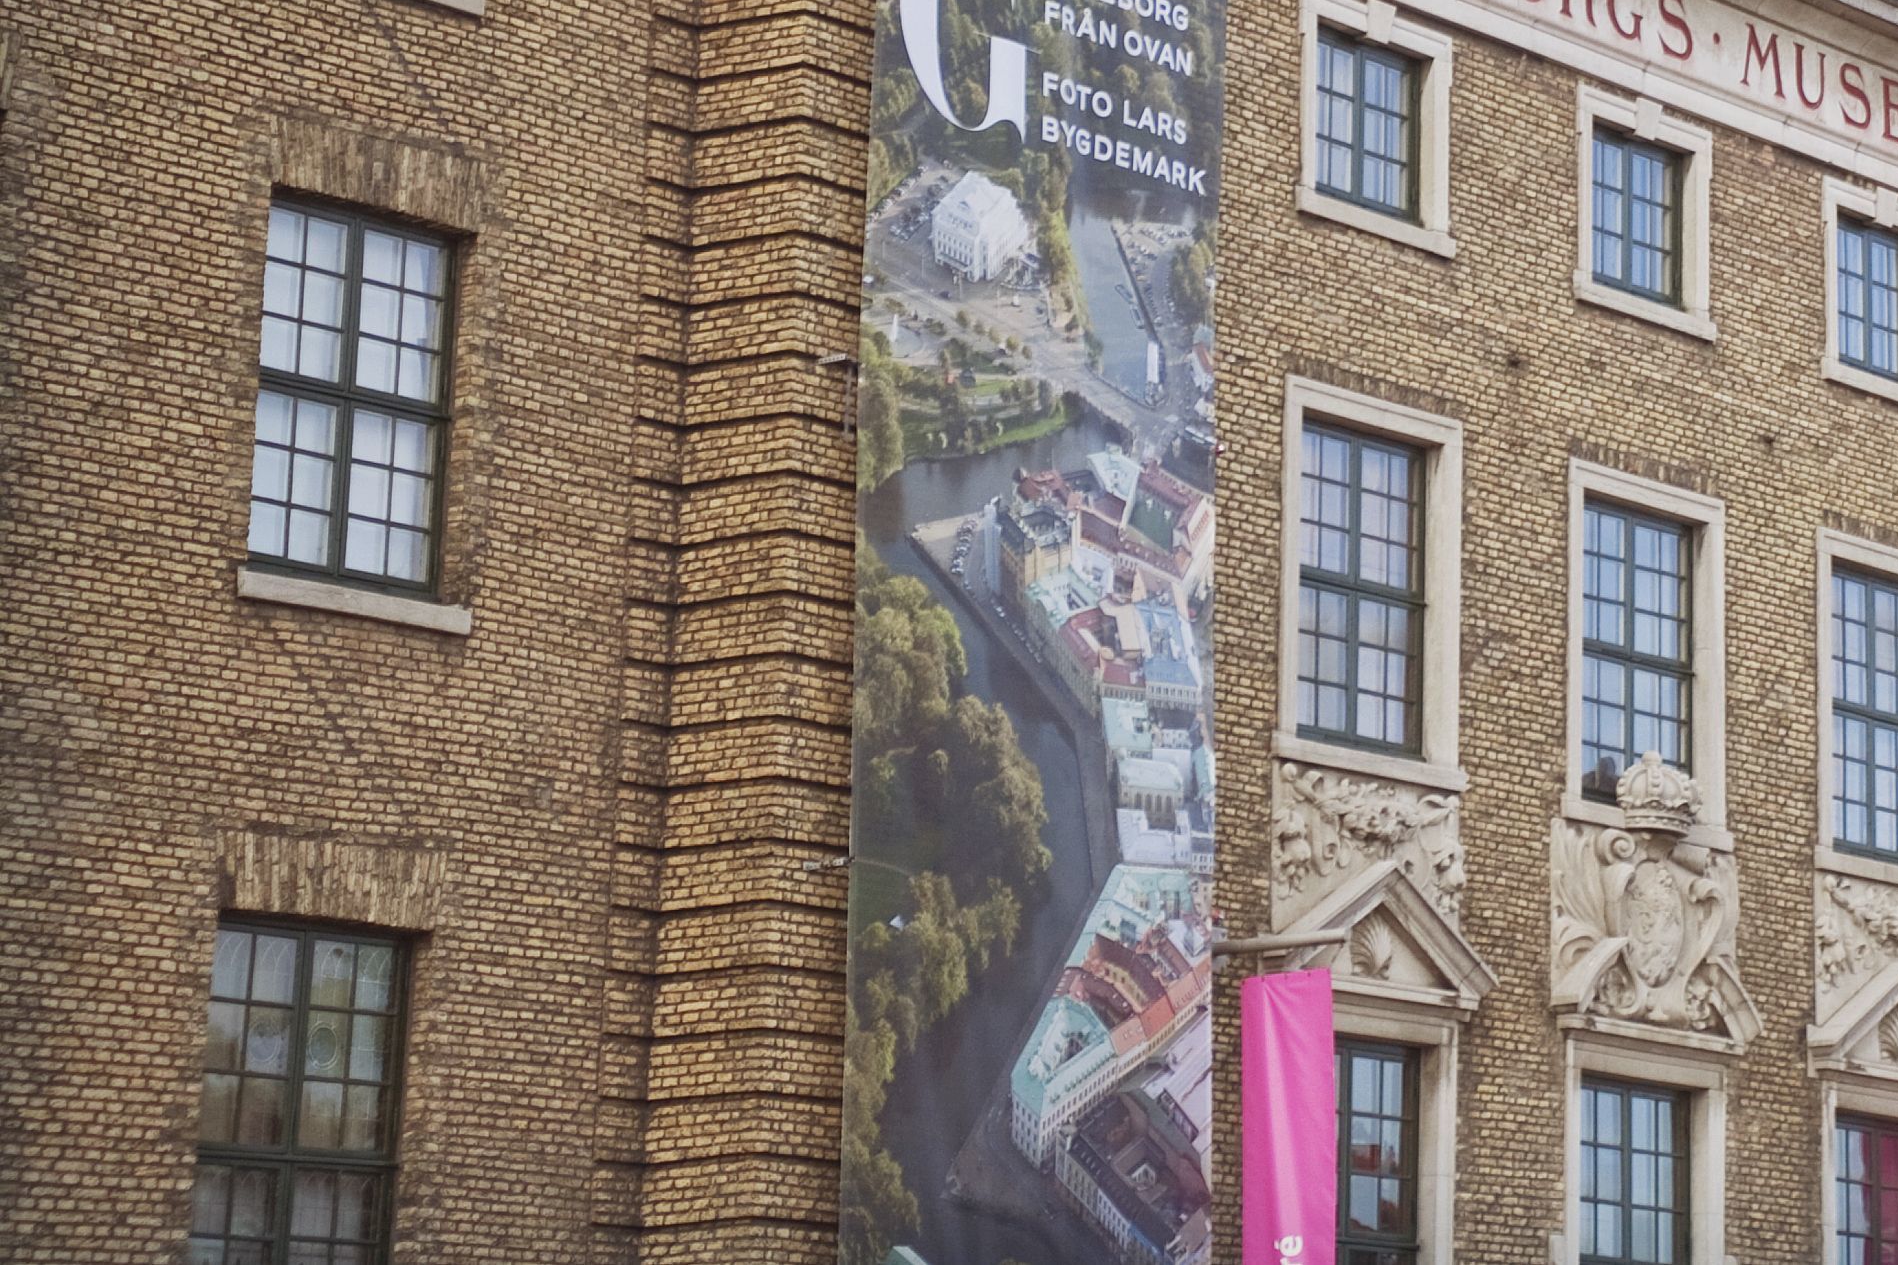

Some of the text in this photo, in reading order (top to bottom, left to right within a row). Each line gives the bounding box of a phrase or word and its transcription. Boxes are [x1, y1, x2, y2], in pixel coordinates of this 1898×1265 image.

[1044, 1, 1192, 77] FRÅN OVAN
[1042, 72, 1187, 145] FOTO LARS
[1042, 116, 1207, 197] BYGDEMARK
